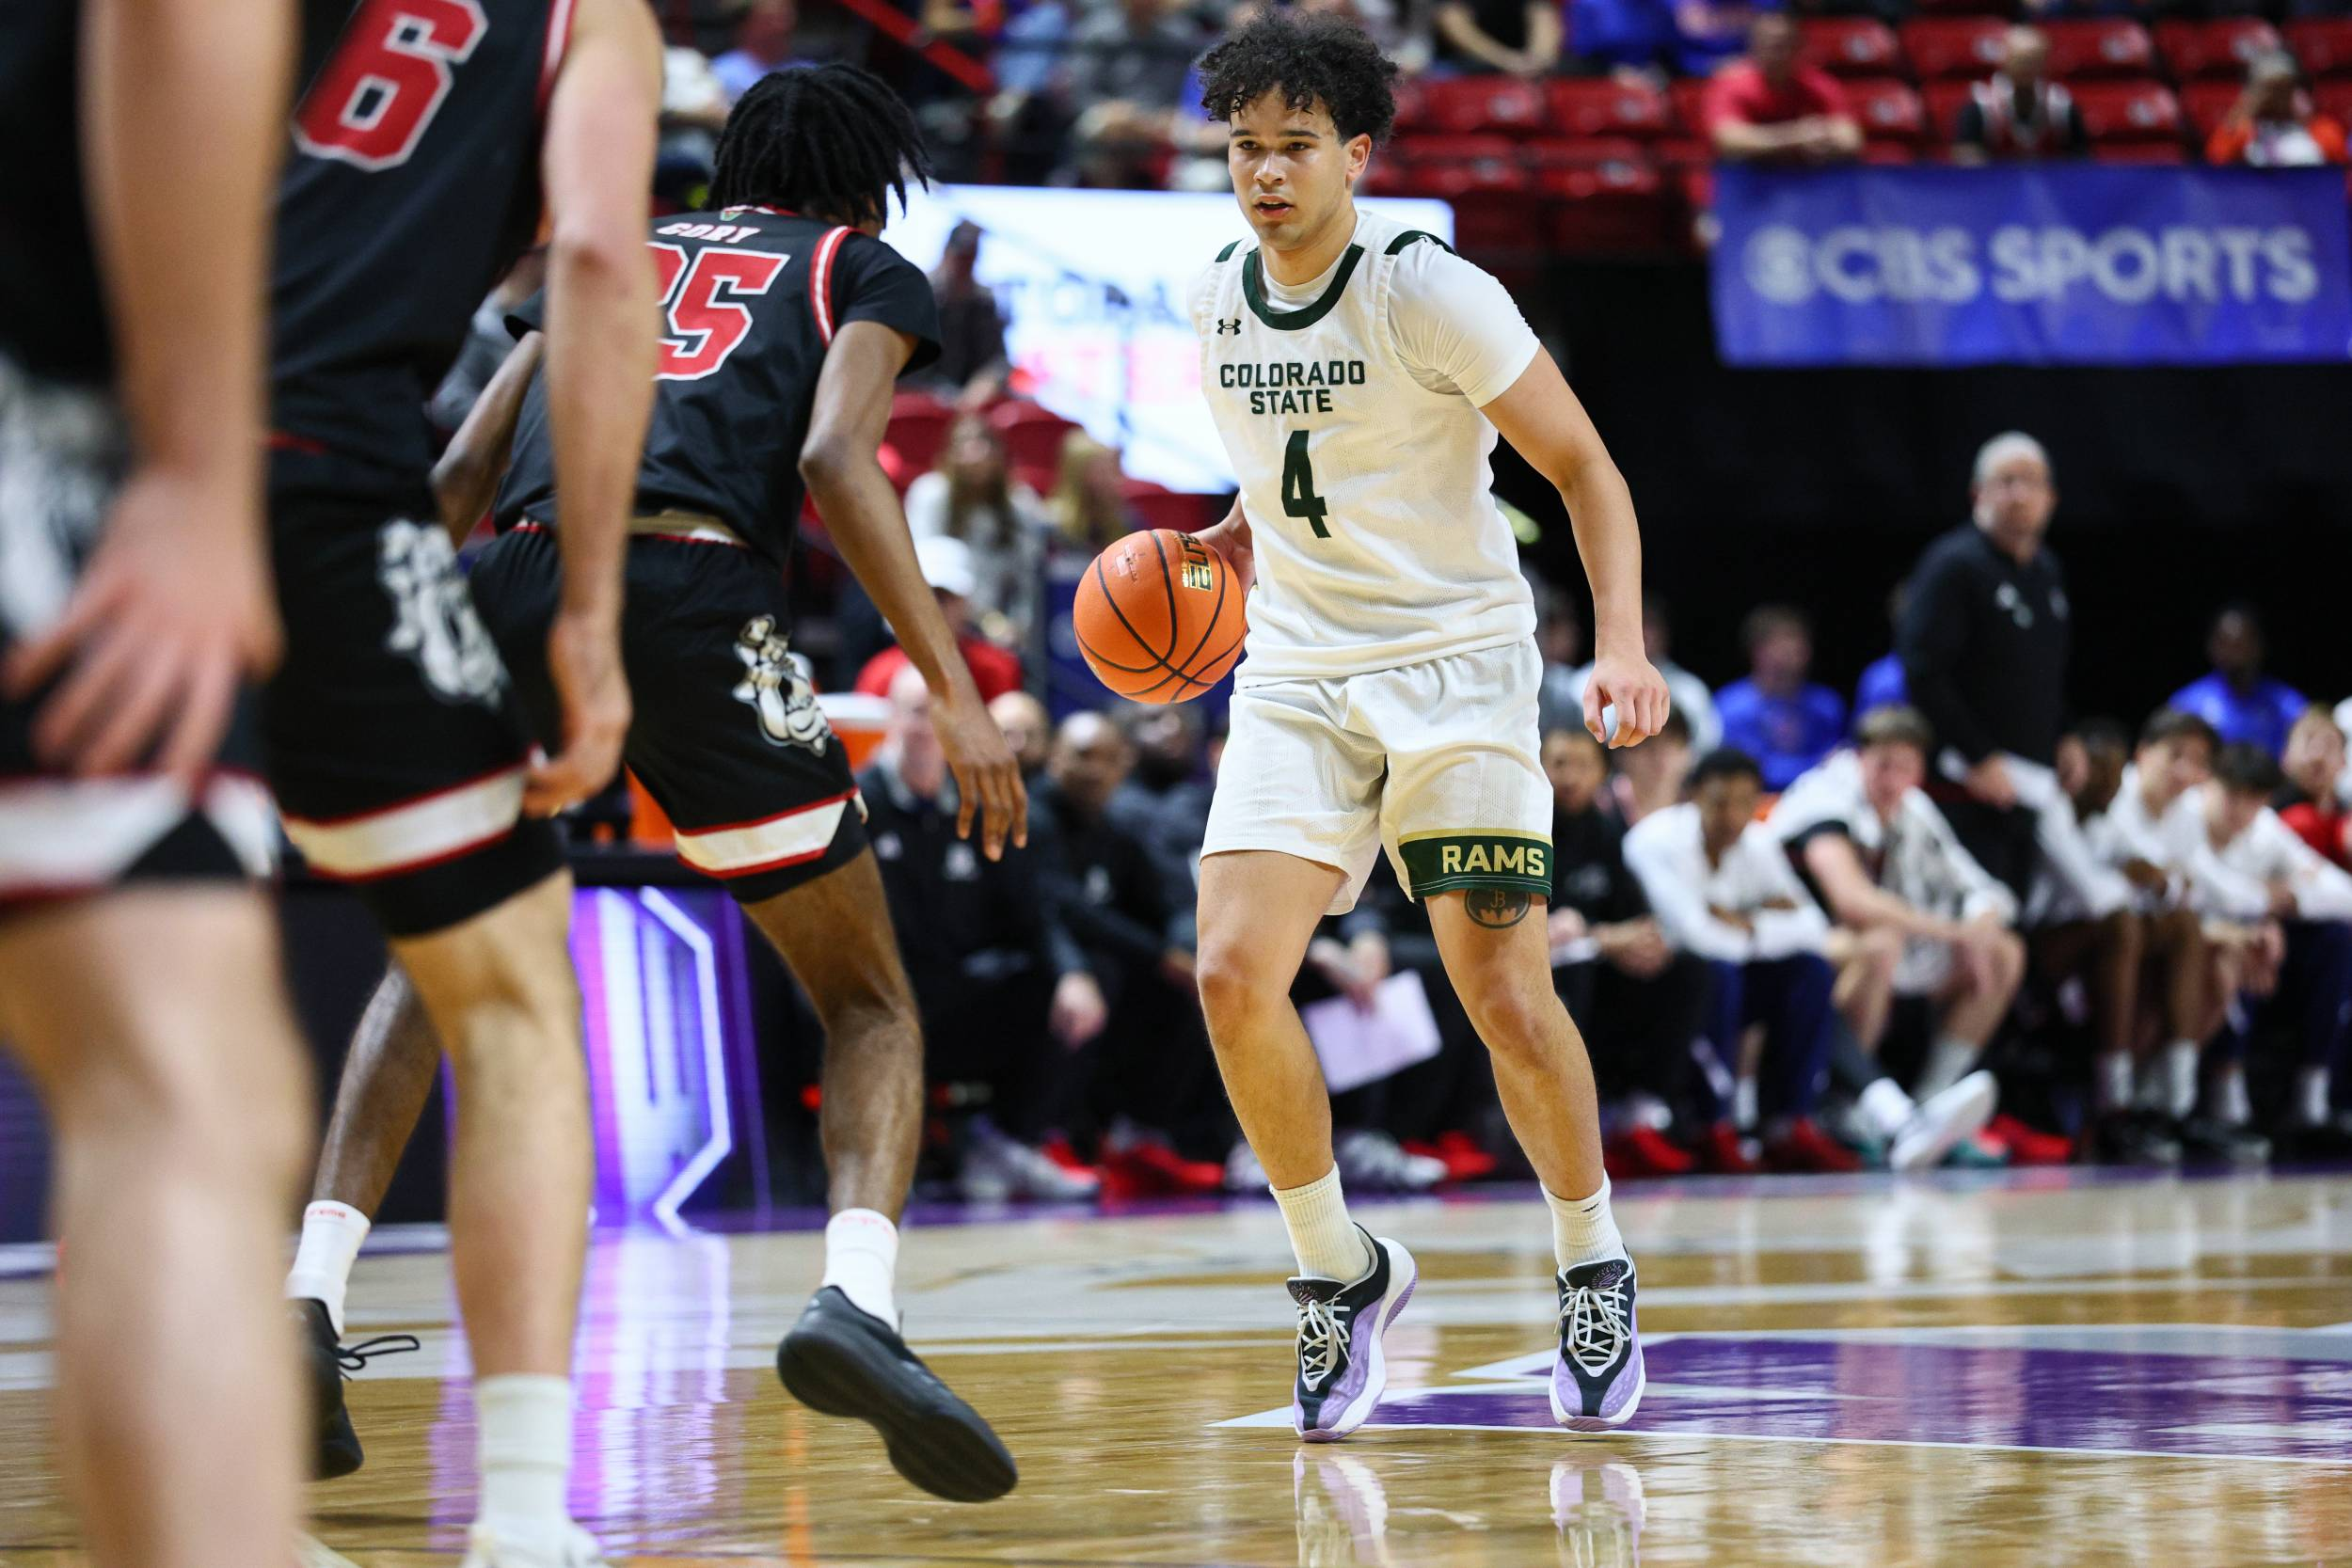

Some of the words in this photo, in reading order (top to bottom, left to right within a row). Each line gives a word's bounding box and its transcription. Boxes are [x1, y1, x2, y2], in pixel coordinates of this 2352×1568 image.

[290, 0, 489, 173] 6
[1816, 225, 1979, 305] CBS
[1990, 225, 2318, 304] SPORTS
[1220, 360, 1366, 388] COLORADO
[1249, 388, 1334, 415] STATE
[1281, 429, 1332, 539] 4
[1441, 844, 1546, 877] RAMS
